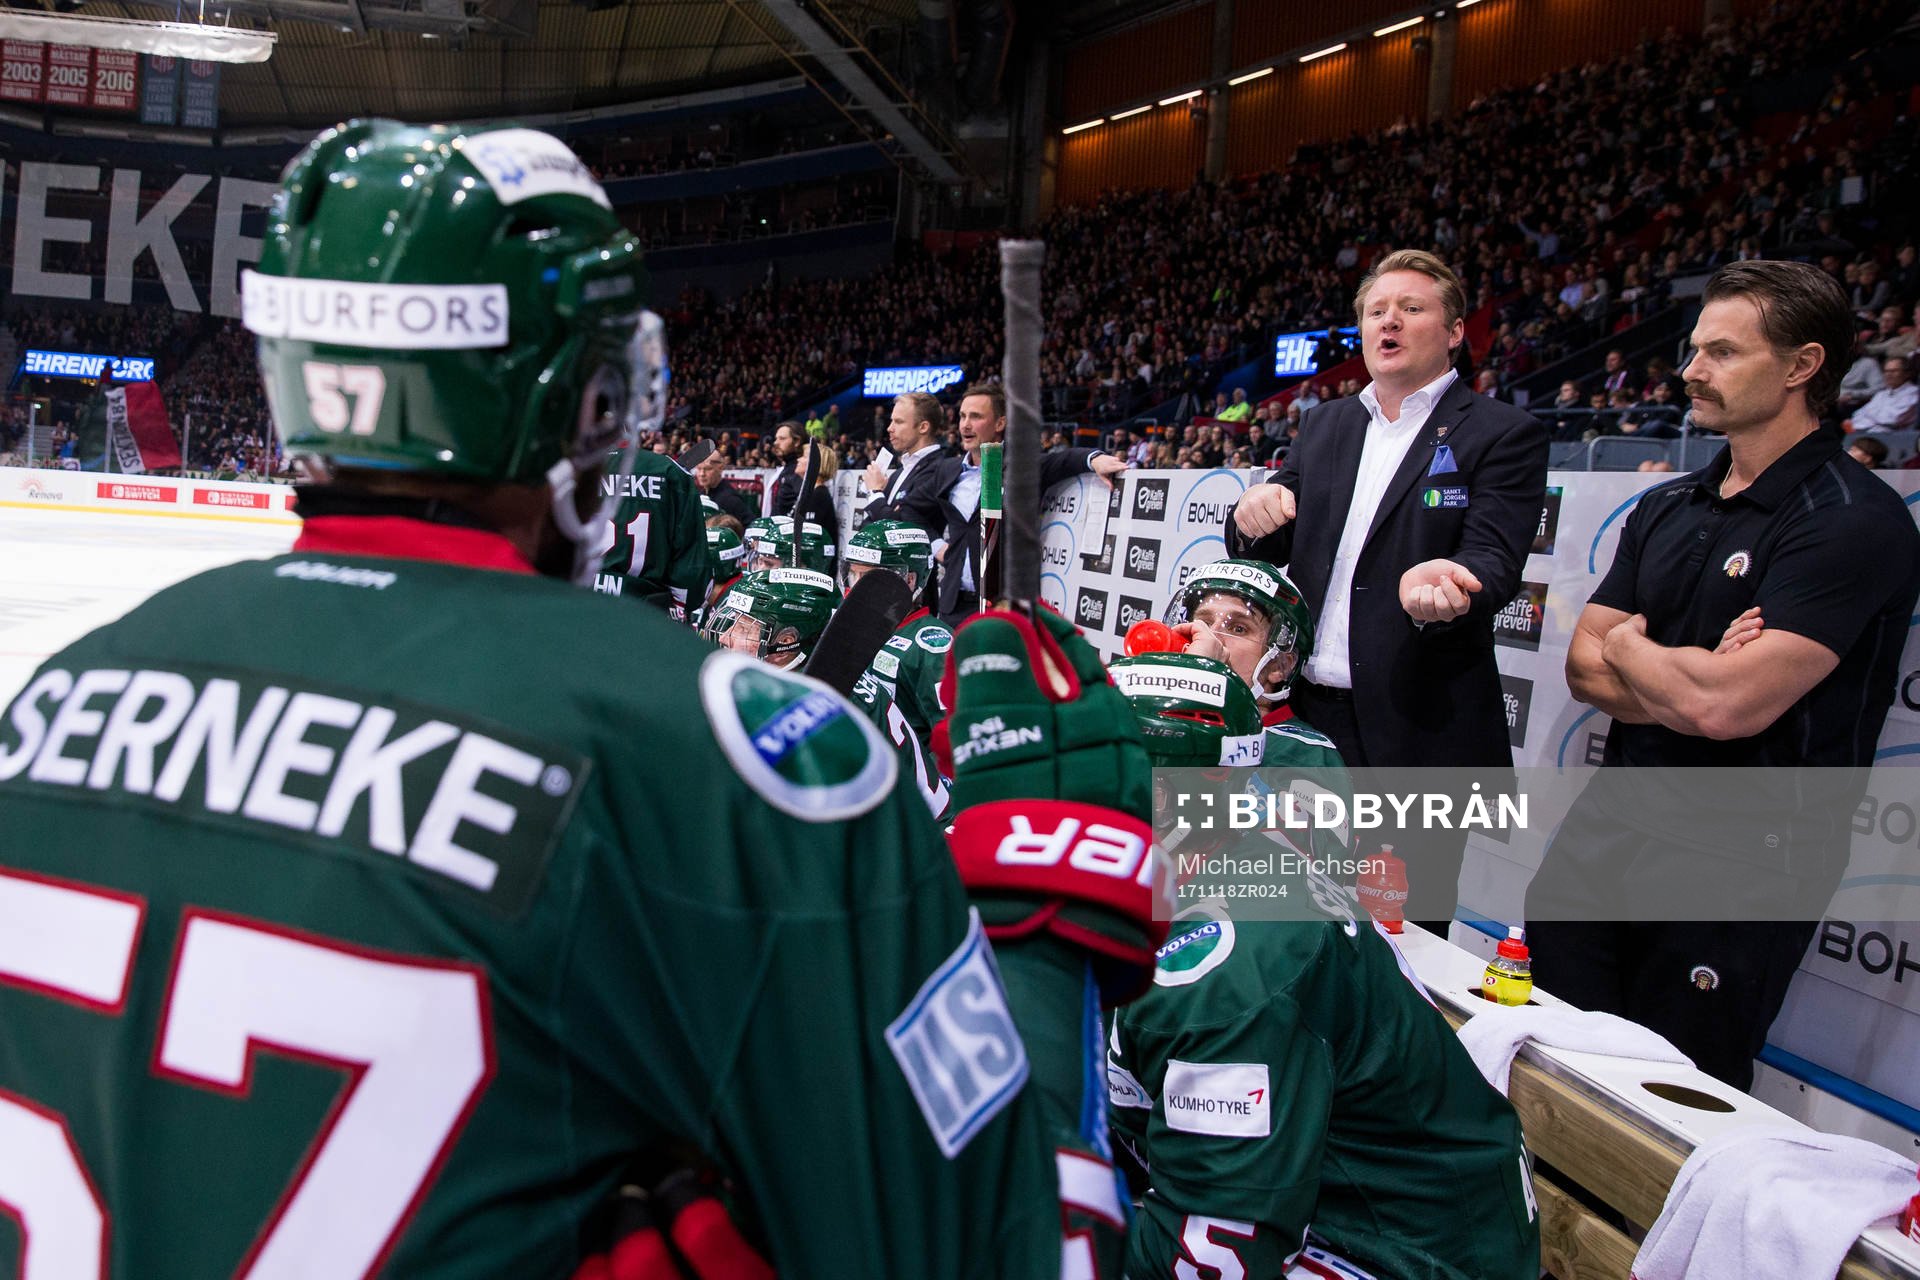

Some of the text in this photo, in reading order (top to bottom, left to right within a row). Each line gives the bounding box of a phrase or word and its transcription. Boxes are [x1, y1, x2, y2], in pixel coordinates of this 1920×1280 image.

[2, 61, 42, 82] 2003
[49, 66, 88, 87] 2005
[96, 69, 135, 91] 2016
[0, 159, 284, 319] EKE
[303, 361, 386, 436] 57
[600, 474, 662, 500] NEKE
[1041, 546, 1067, 566] OHUS
[593, 573, 623, 597] HN
[1126, 673, 1222, 697] Tranpenad
[0, 668, 545, 893] SERNEKE
[1154, 921, 1218, 961] VOLVO
[1169, 1095, 1251, 1115] KUMHO TYRE
